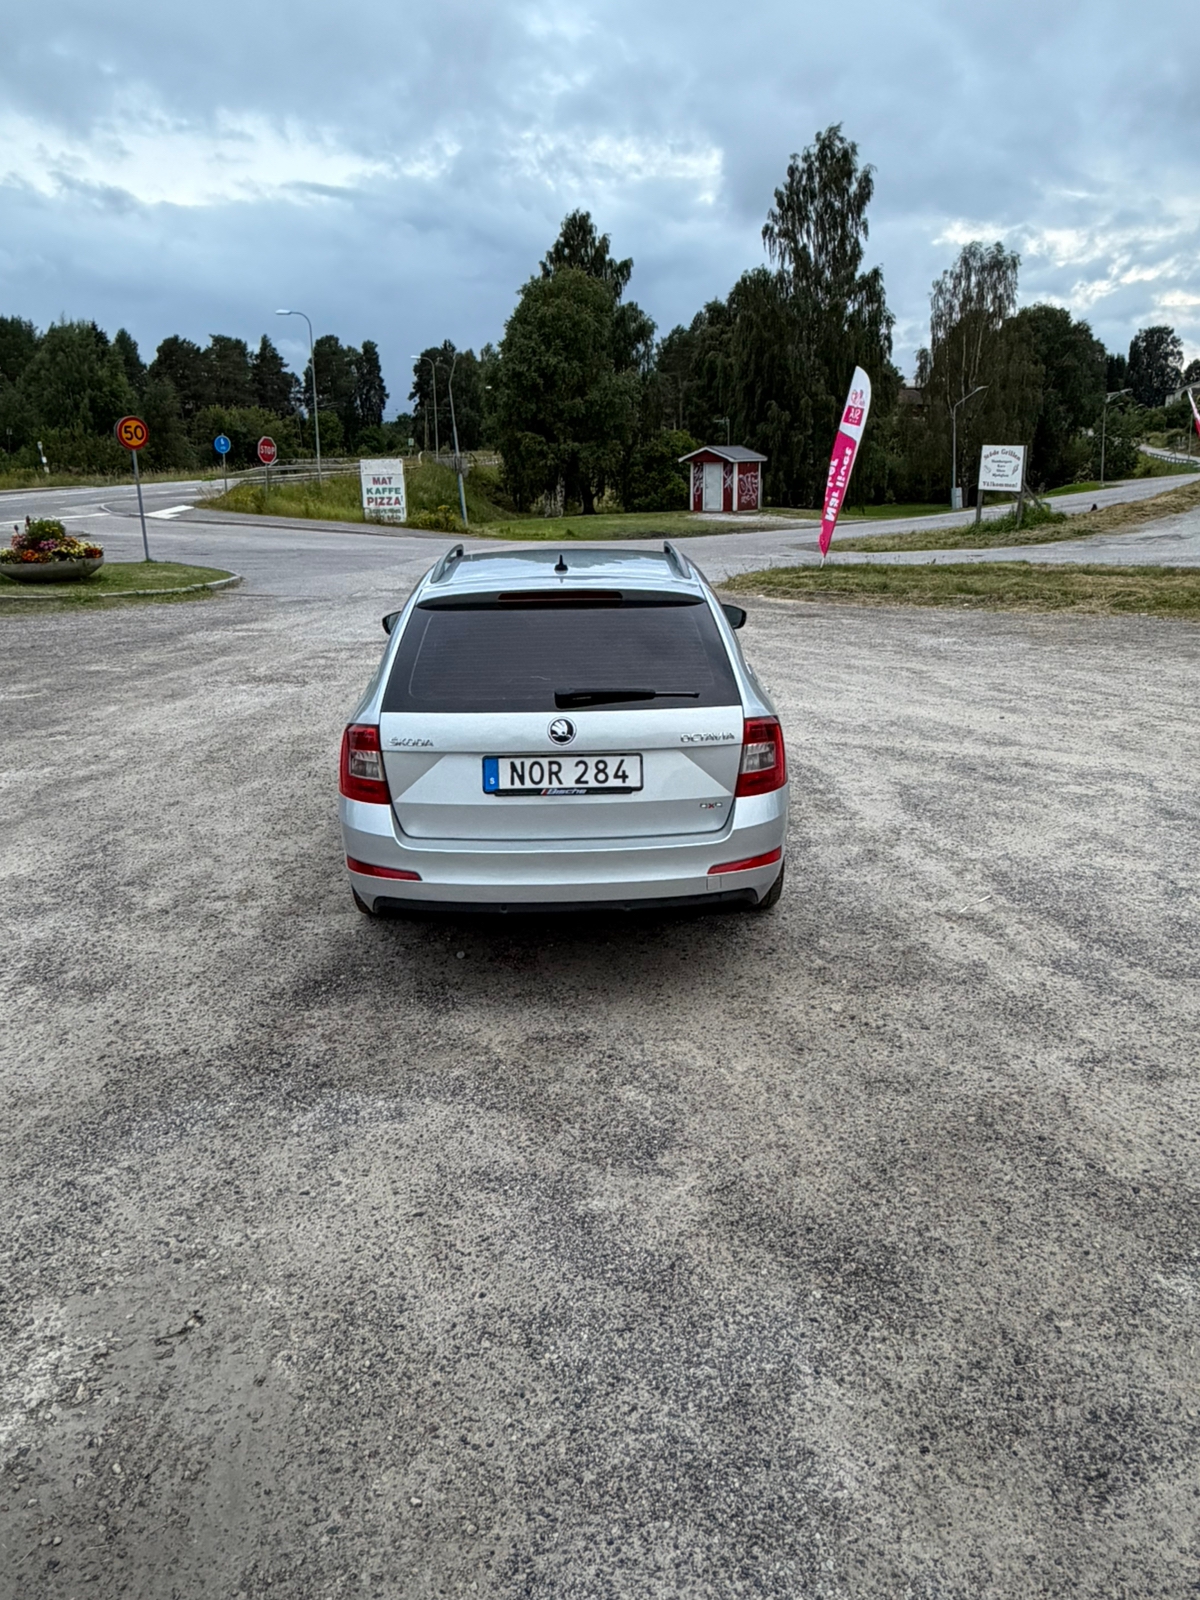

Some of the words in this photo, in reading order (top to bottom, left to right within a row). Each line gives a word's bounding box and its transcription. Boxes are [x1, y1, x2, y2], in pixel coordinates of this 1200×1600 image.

[123, 424, 144, 441] 50
[260, 445, 275, 455] STOP
[1001, 448, 1021, 461] Grillen
[372, 477, 393, 485] MAT
[366, 497, 401, 506] PIZZA
[389, 736, 434, 746] ŠKODA
[680, 732, 735, 743] OCTAVIA
[510, 761, 563, 786] NOR
[574, 760, 628, 784] 284
